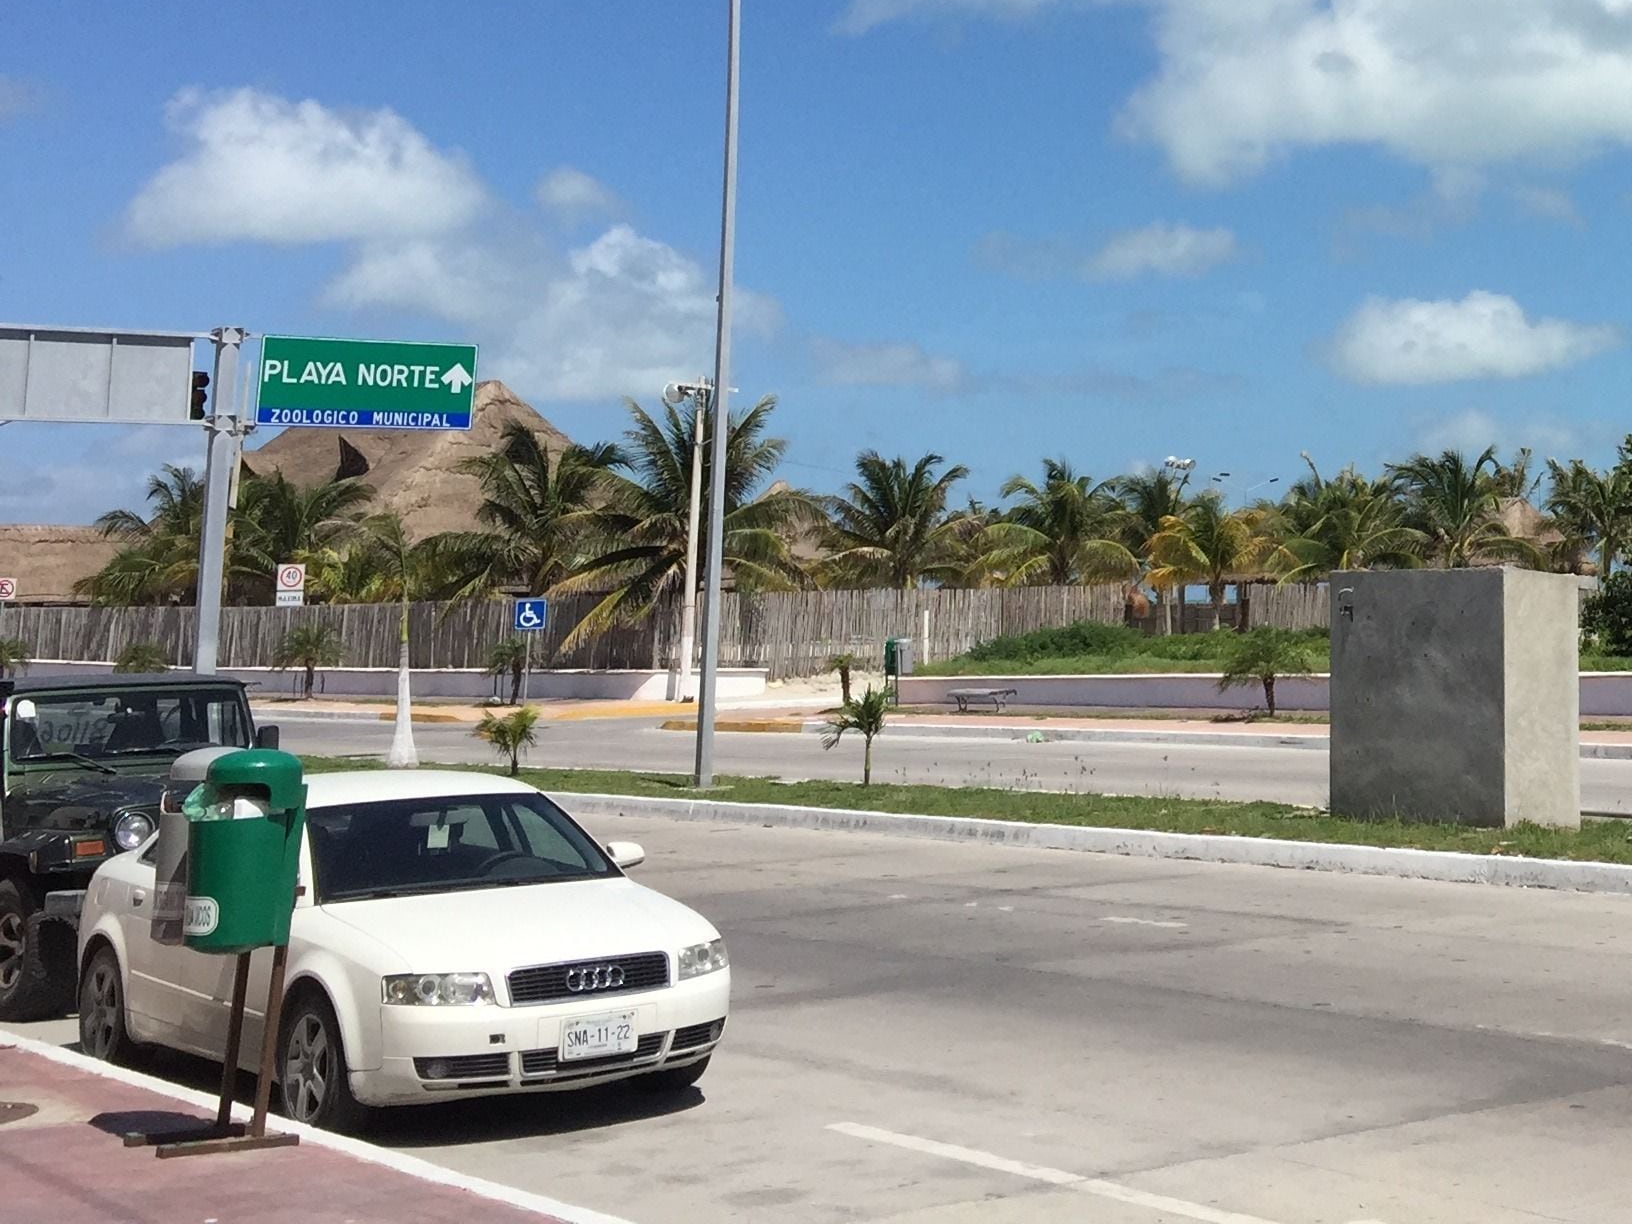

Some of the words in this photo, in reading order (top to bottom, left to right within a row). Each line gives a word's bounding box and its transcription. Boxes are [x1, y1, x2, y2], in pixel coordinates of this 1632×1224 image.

[263, 360, 347, 385] PLAYA
[357, 363, 440, 388] NORTE
[270, 409, 359, 424] ZOOLOGICO
[372, 411, 450, 427] MUNICIPAL
[286, 570, 298, 580] 40
[567, 1024, 630, 1048] SNA-11-22
